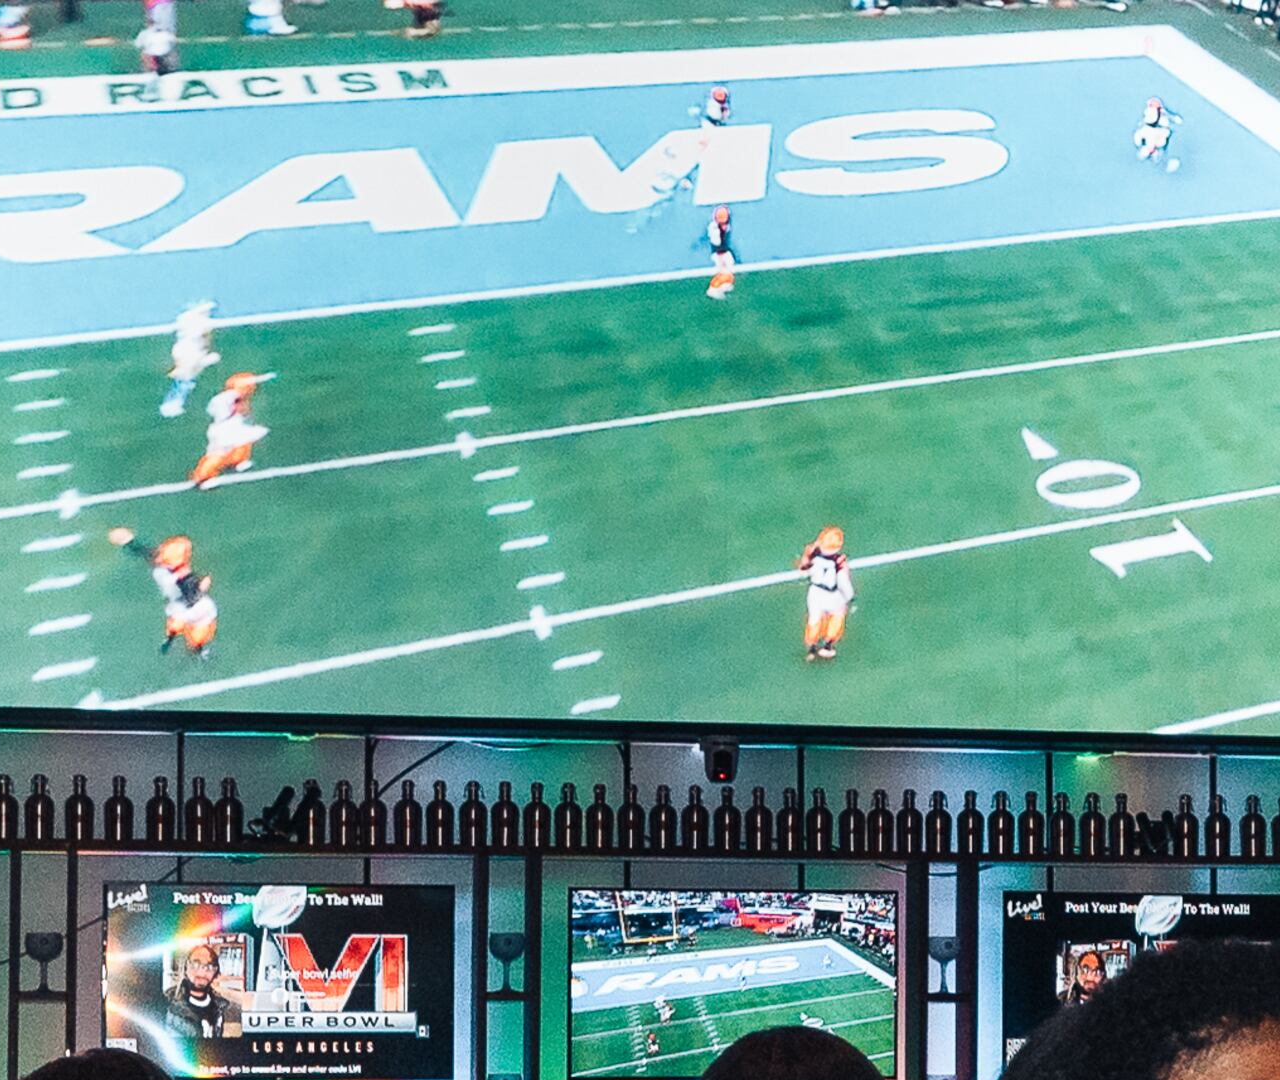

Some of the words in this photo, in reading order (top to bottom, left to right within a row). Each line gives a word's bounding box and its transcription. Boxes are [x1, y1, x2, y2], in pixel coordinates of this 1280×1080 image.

[108, 69, 450, 105] RACISM
[173, 892, 200, 905] Post
[202, 892, 234, 905] Your
[308, 894, 324, 906] To
[325, 893, 349, 906] The
[350, 893, 383, 906] Wall!
[1065, 902, 1089, 914] Post
[1091, 902, 1118, 914] Your
[1184, 903, 1197, 915] To
[1200, 903, 1220, 915] The
[1223, 904, 1251, 915] Wall!
[593, 955, 800, 997] RAMS
[248, 1015, 315, 1029] UPER
[326, 1015, 395, 1029] BOWL
[252, 1041, 284, 1054] LOS
[295, 1041, 375, 1054] ANGELES
[231, 1066, 241, 1076] go
[242, 1064, 250, 1074] to
[292, 1064, 307, 1074] and
[308, 1064, 327, 1074] enter
[328, 1064, 348, 1074] code
